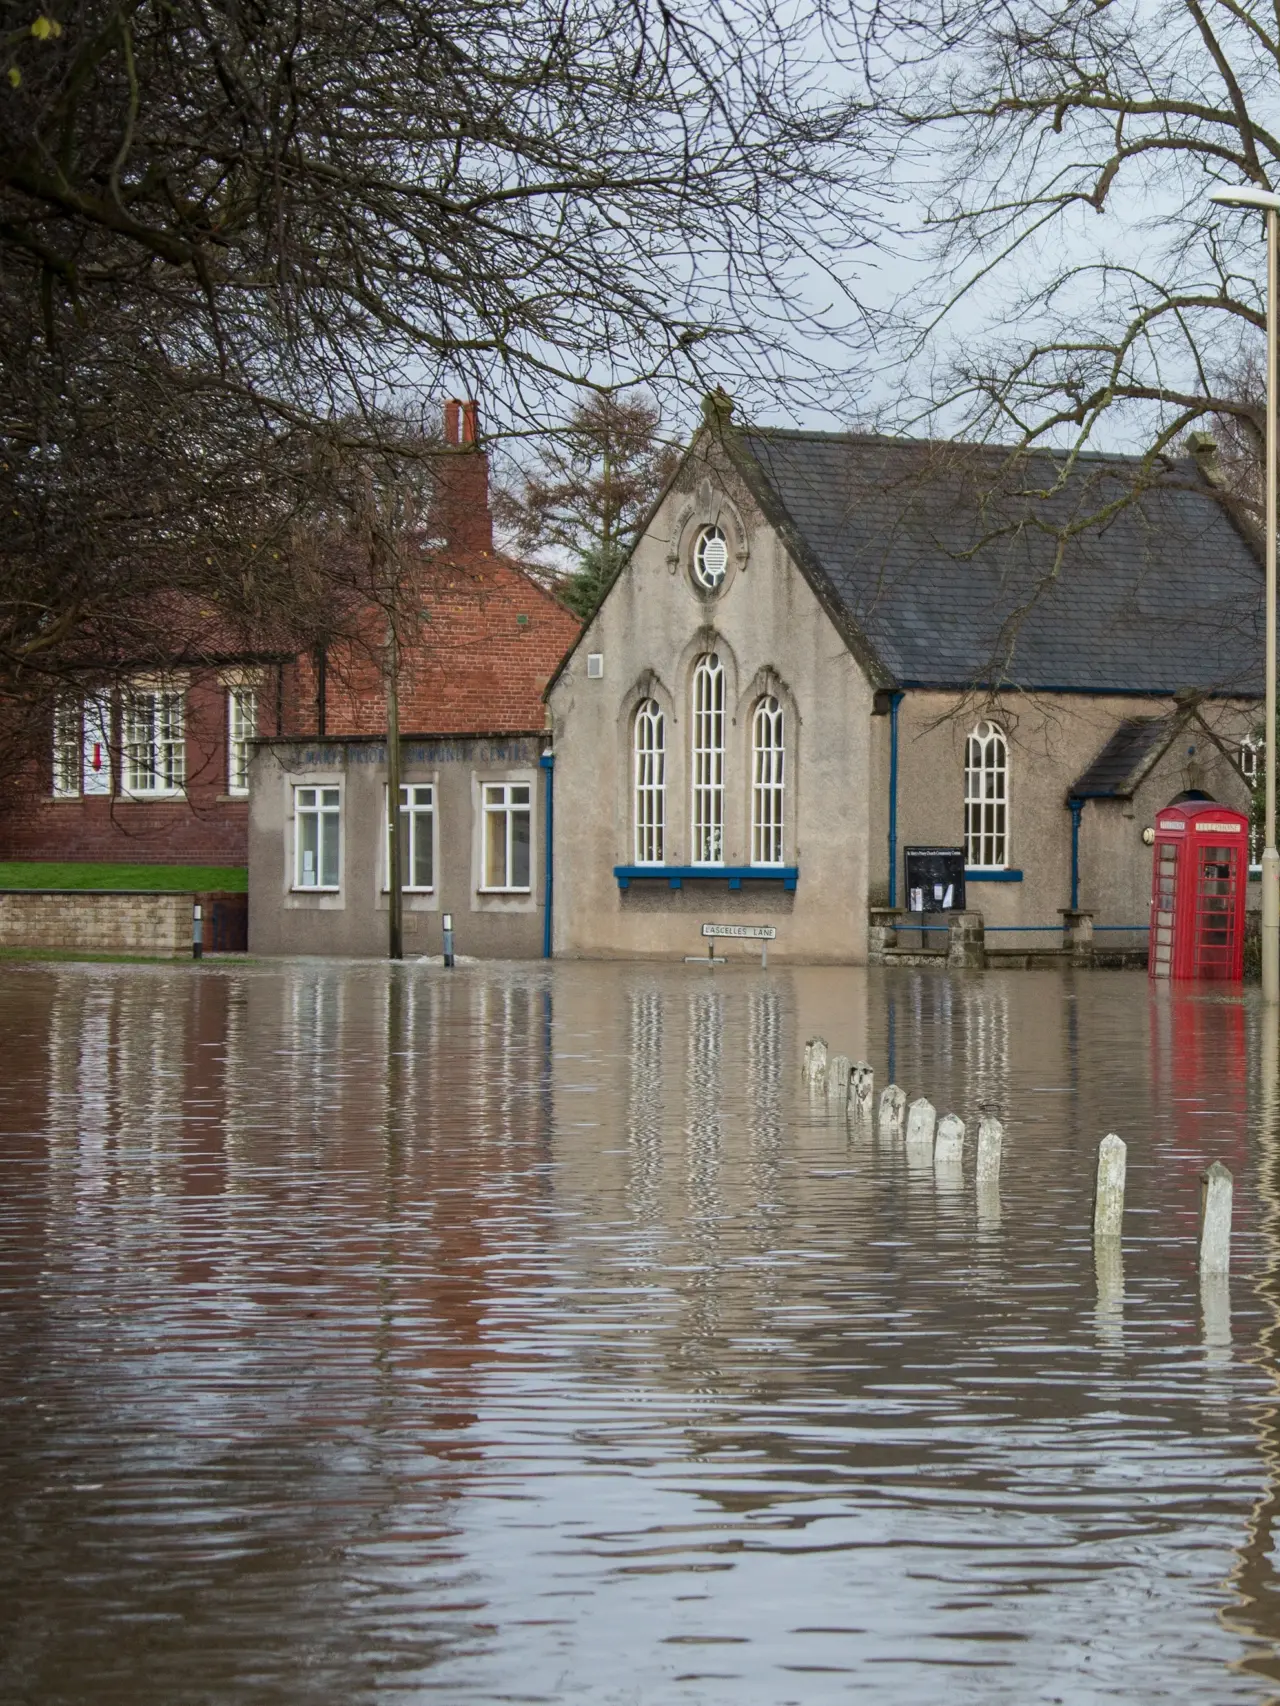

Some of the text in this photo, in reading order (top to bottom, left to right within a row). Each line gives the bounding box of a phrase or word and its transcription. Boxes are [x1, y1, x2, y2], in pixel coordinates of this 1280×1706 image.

[404, 746, 473, 763] OMMUNITY
[1198, 823, 1239, 831] TELEPHONE
[705, 926, 747, 935] LASCELLES
